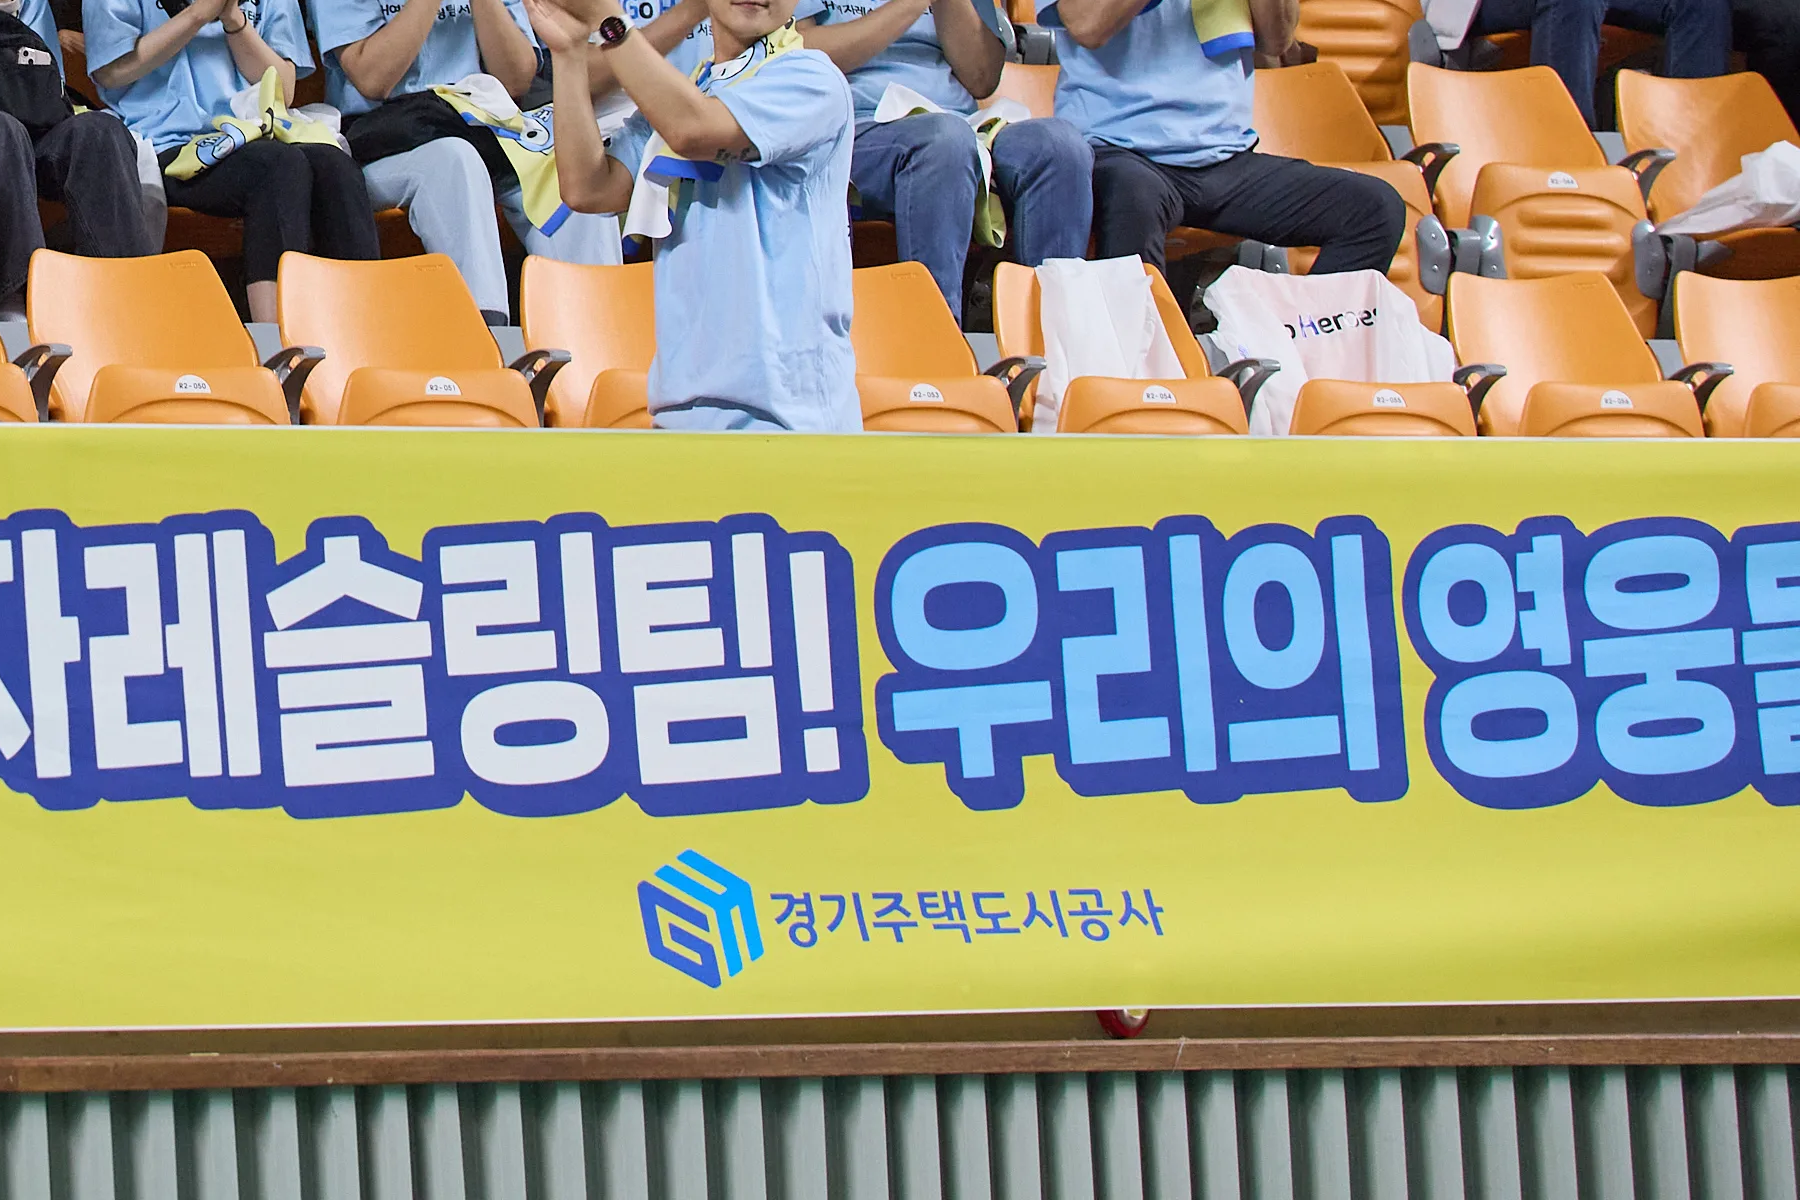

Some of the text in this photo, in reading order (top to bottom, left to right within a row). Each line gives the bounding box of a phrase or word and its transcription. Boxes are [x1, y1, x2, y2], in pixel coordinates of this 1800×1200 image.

[178, 382, 207, 390] R2-050
[429, 384, 456, 392] R2-051
[889, 532, 1382, 781] 우리의
[769, 887, 1165, 948] 경기주택도시공사
